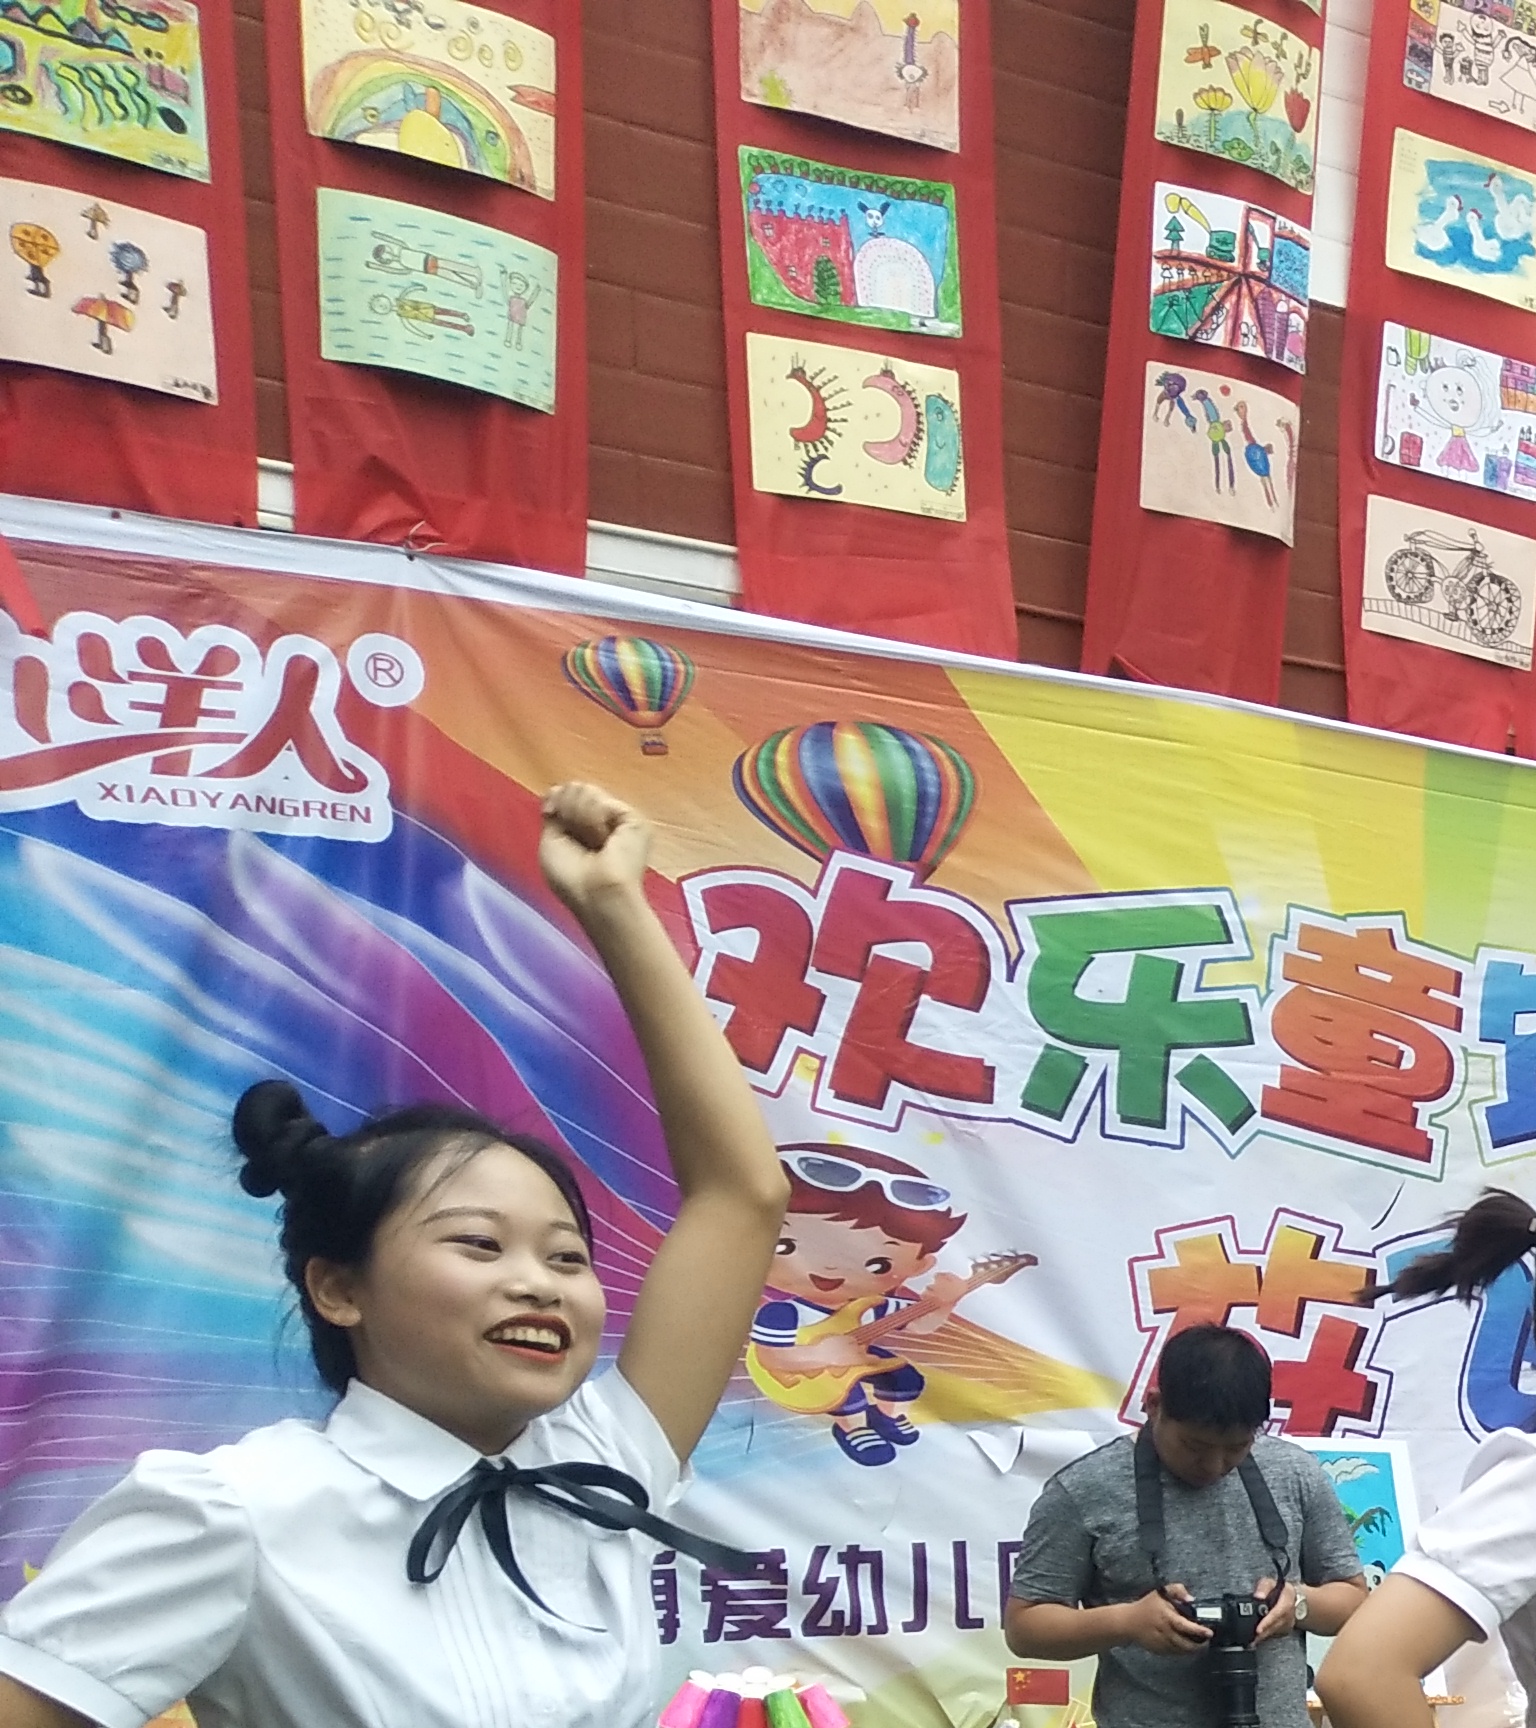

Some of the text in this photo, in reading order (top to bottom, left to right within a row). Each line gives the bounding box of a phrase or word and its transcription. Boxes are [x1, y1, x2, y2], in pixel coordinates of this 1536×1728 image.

[97, 780, 373, 825] XIAOYANGREN
[650, 1540, 1026, 1646] 爱幼儿
